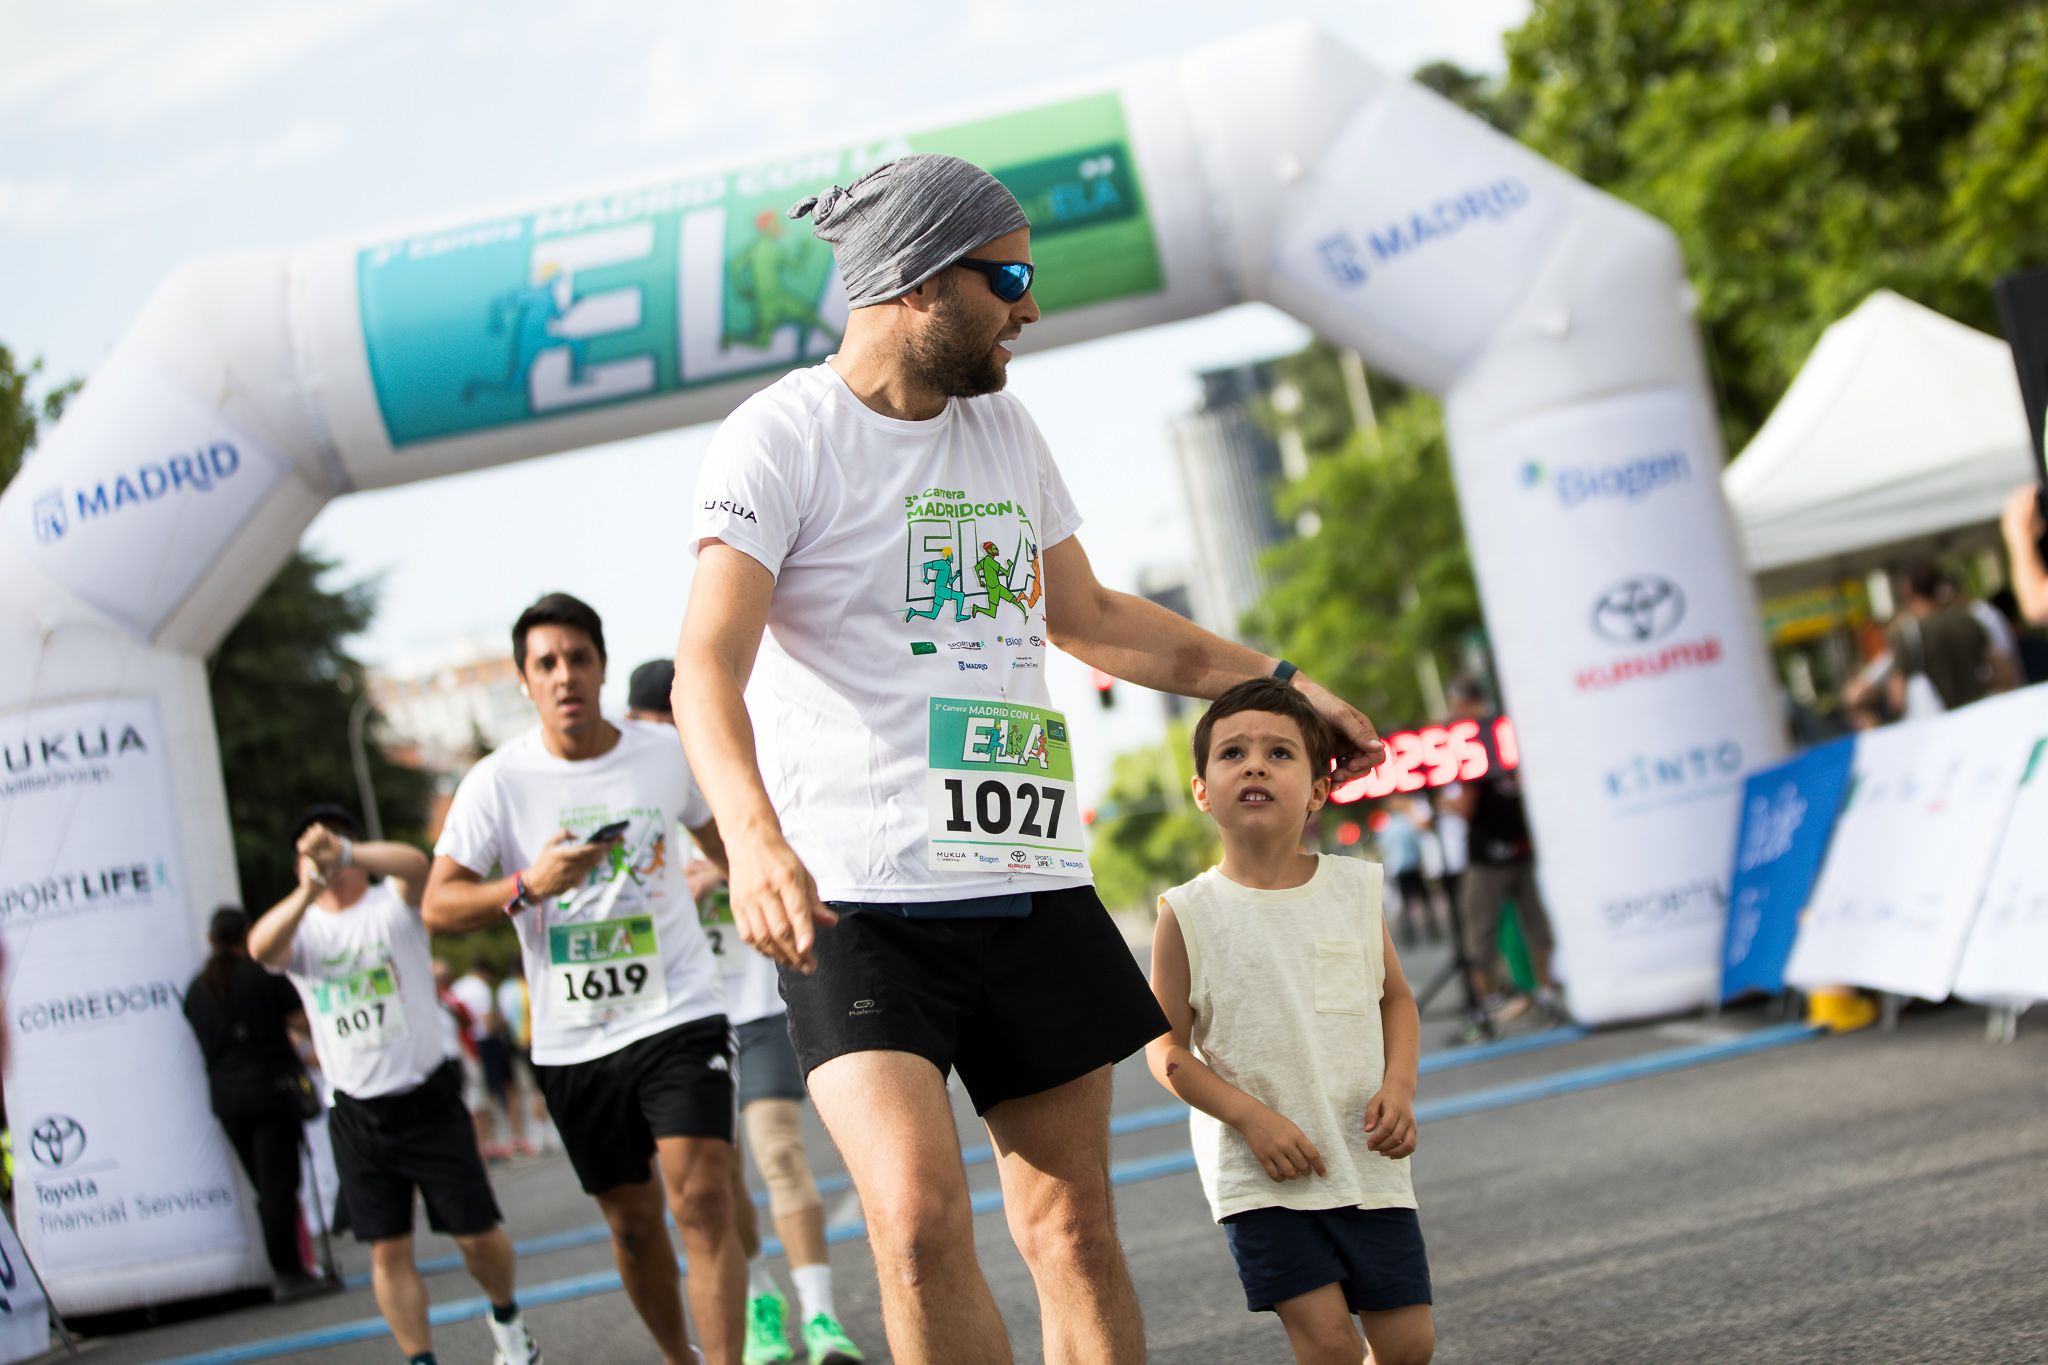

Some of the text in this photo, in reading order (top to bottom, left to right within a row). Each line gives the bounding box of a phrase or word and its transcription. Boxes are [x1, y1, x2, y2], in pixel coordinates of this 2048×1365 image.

[533, 178, 727, 236] MADRID
[735, 153, 841, 195] CON
[1370, 177, 1530, 260] MADRID
[529, 204, 845, 414] EL
[77, 440, 240, 519] MADRID
[1556, 452, 1692, 506] Biogen
[704, 500, 758, 524] UKUA
[907, 502, 973, 519] MADRID
[974, 500, 1013, 517] CON
[965, 663, 988, 671] MADRID
[968, 705, 1009, 717] MADRID
[1010, 709, 1029, 720] CON
[1030, 712, 1040, 721] LA
[2, 722, 147, 773] UKUA
[961, 717, 1048, 769] ELA
[944, 779, 1065, 839] 1027
[936, 851, 967, 859] MUKUA
[979, 855, 999, 864] Biogen
[1065, 861, 1084, 869] MADRID
[567, 925, 634, 961] ELA
[564, 962, 648, 1001] 1619
[337, 1002, 385, 1037] 807
[35, 1178, 98, 1207] Toyota
[39, 1186, 233, 1233] Financial Services
